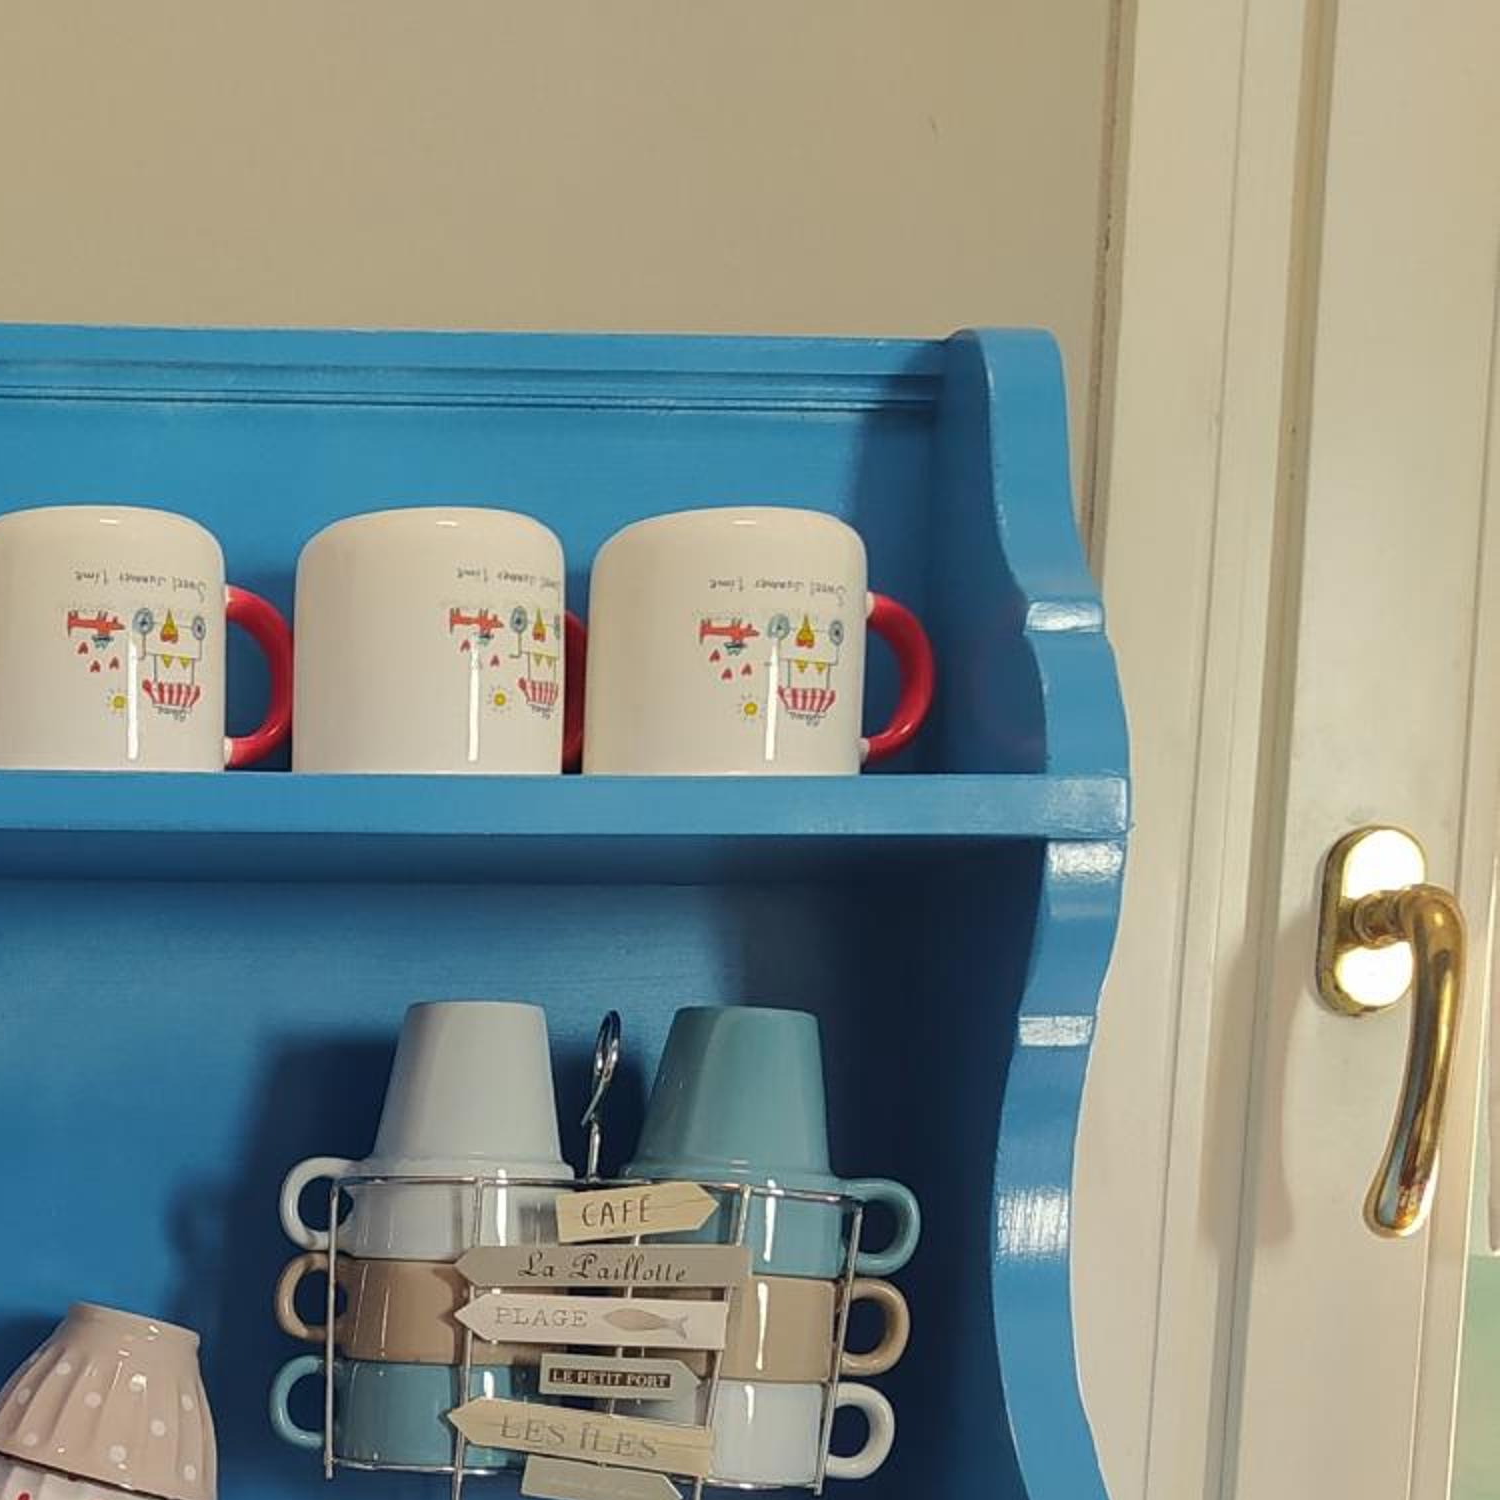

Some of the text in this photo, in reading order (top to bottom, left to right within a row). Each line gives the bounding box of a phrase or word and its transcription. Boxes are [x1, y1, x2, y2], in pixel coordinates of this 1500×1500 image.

[516, 1250, 689, 1283] La Paillotte
[494, 1306, 589, 1329] PLAGE
[552, 1368, 669, 1389] LE PETIT PORT
[500, 1415, 566, 1444] LES
